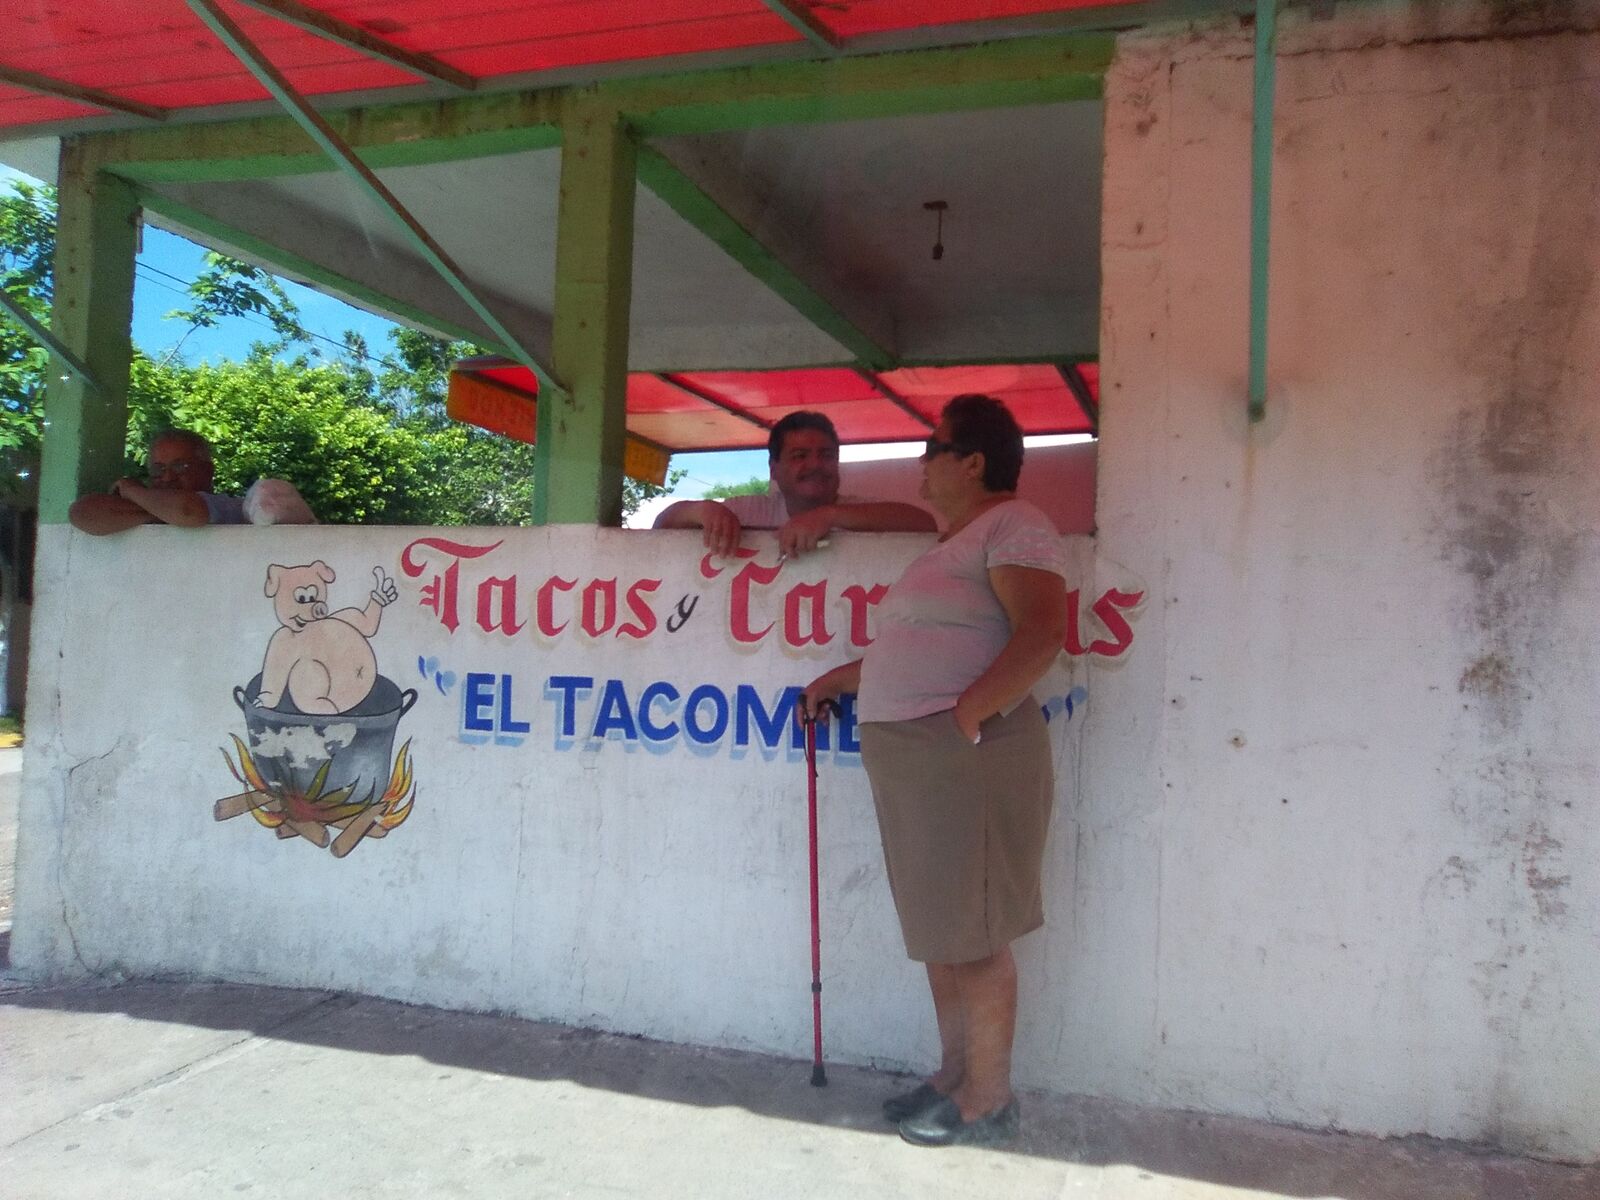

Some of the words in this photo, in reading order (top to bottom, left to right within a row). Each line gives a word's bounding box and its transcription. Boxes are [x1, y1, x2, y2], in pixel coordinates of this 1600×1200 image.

[401, 537, 663, 639] Tacos
[666, 593, 699, 633] y
[700, 547, 1145, 657] Cars
